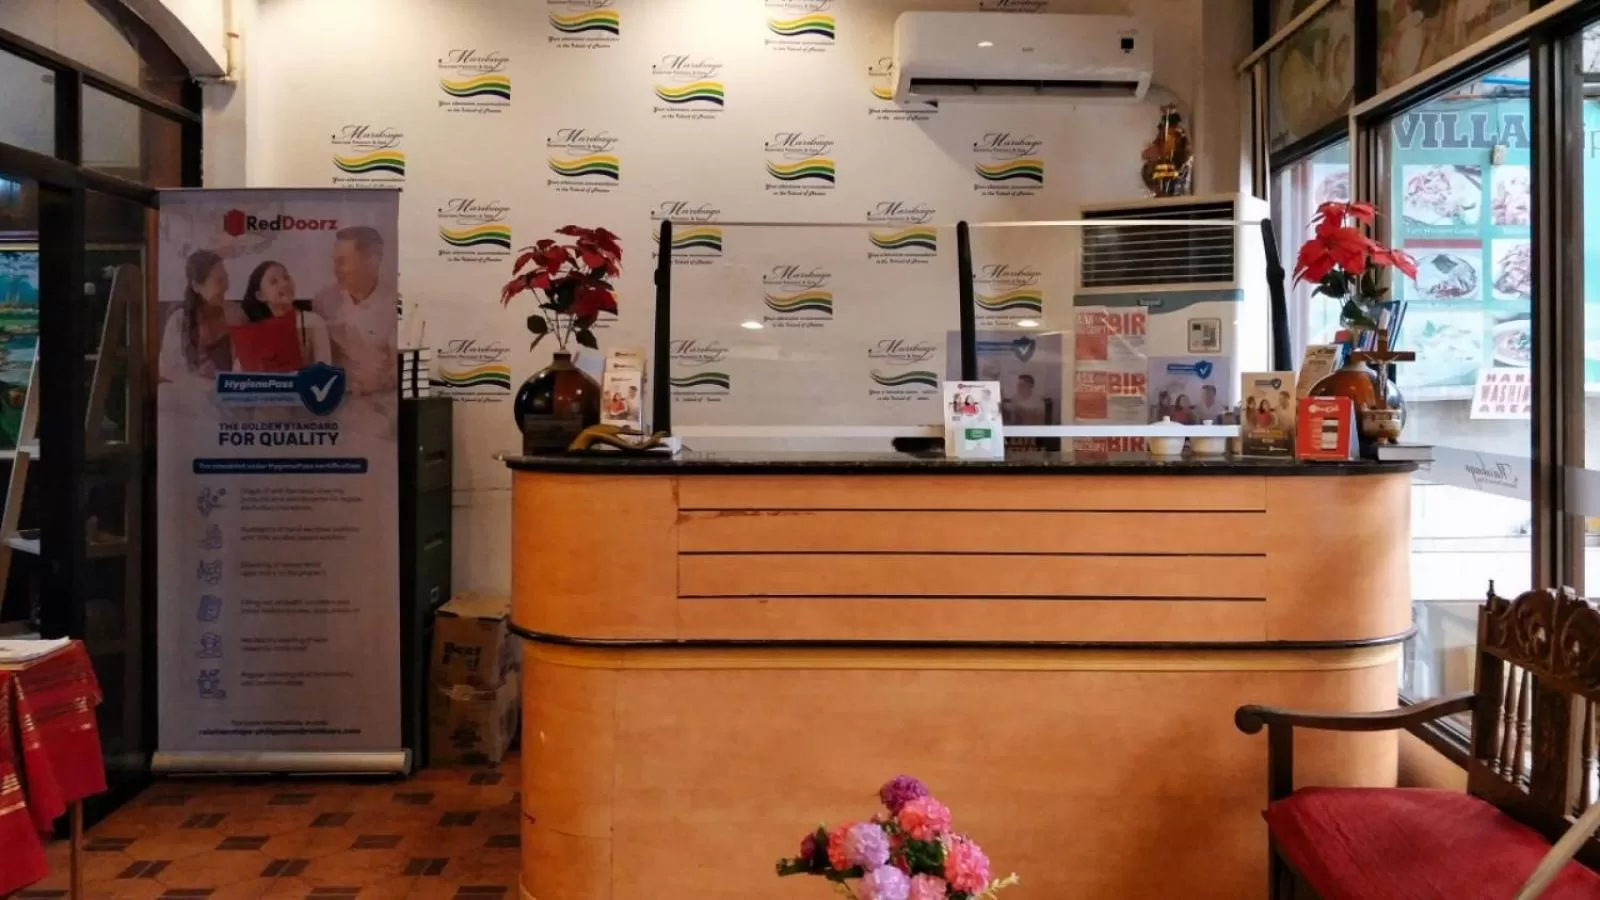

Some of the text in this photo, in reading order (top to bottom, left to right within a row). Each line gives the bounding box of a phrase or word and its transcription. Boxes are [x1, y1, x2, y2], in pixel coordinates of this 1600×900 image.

[1393, 111, 1531, 149] VILLA
[246, 214, 338, 231] RedDoorz
[1108, 312, 1147, 335] BIR
[224, 379, 294, 390] HygienePass
[1108, 372, 1147, 394] BIR
[1481, 384, 1530, 402] WASHIN
[219, 422, 338, 431] THE GOLDEN STANDARD
[219, 432, 339, 447] FOR QUALITY
